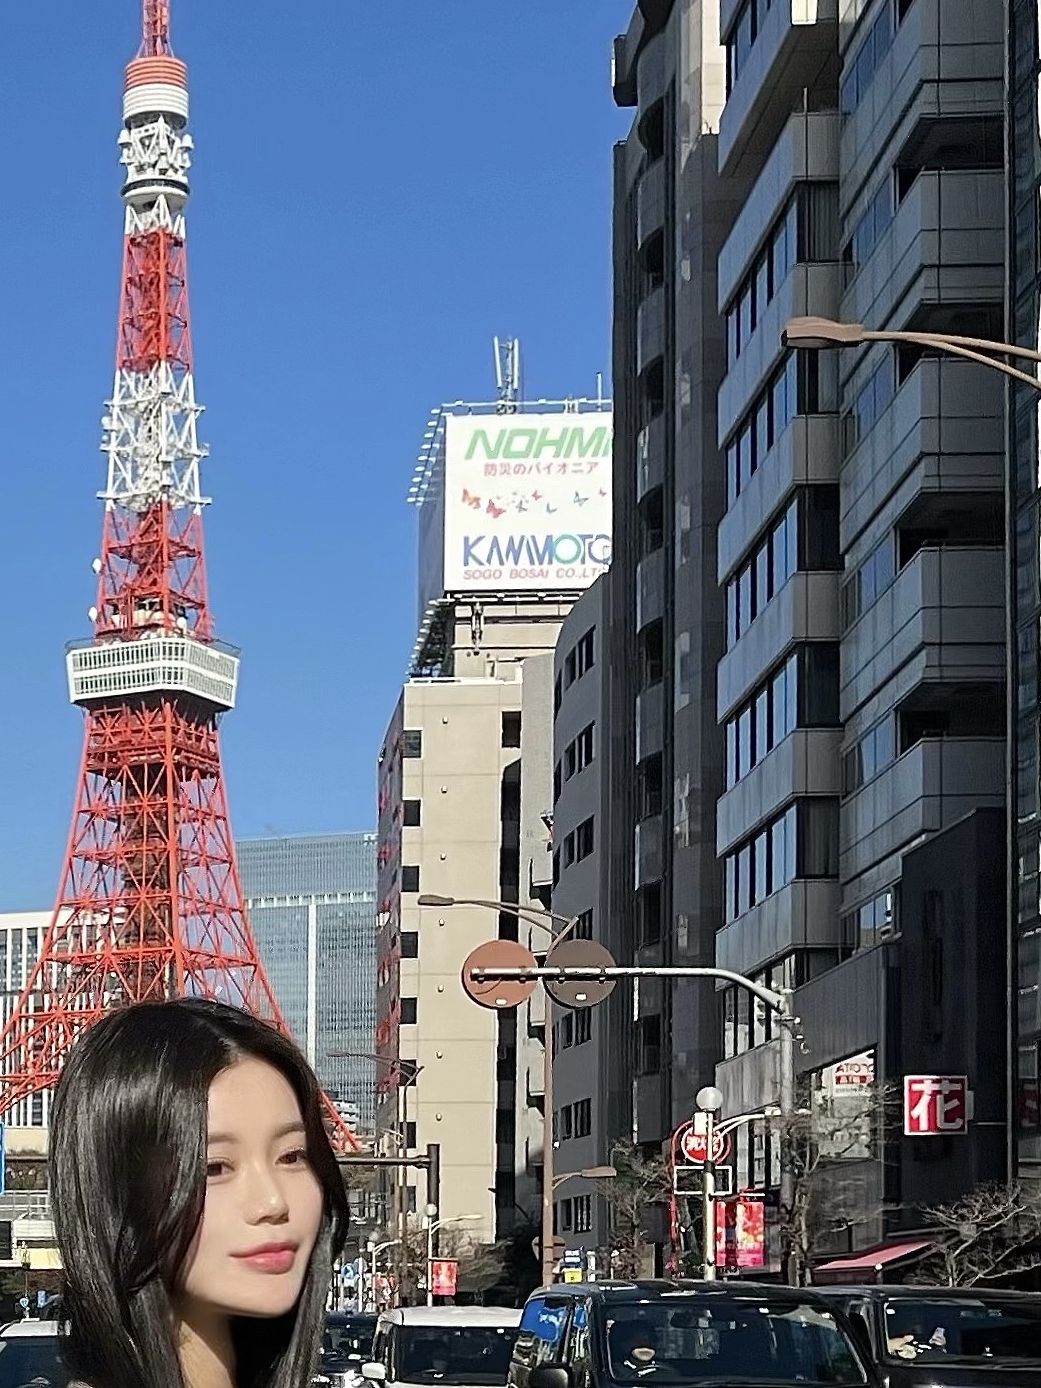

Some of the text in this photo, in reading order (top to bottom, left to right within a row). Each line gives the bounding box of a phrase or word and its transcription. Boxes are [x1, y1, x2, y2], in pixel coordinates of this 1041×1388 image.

[463, 569, 502, 580] SOGO
[509, 568, 549, 579] BOSAI
[911, 1079, 963, 1132] 花
